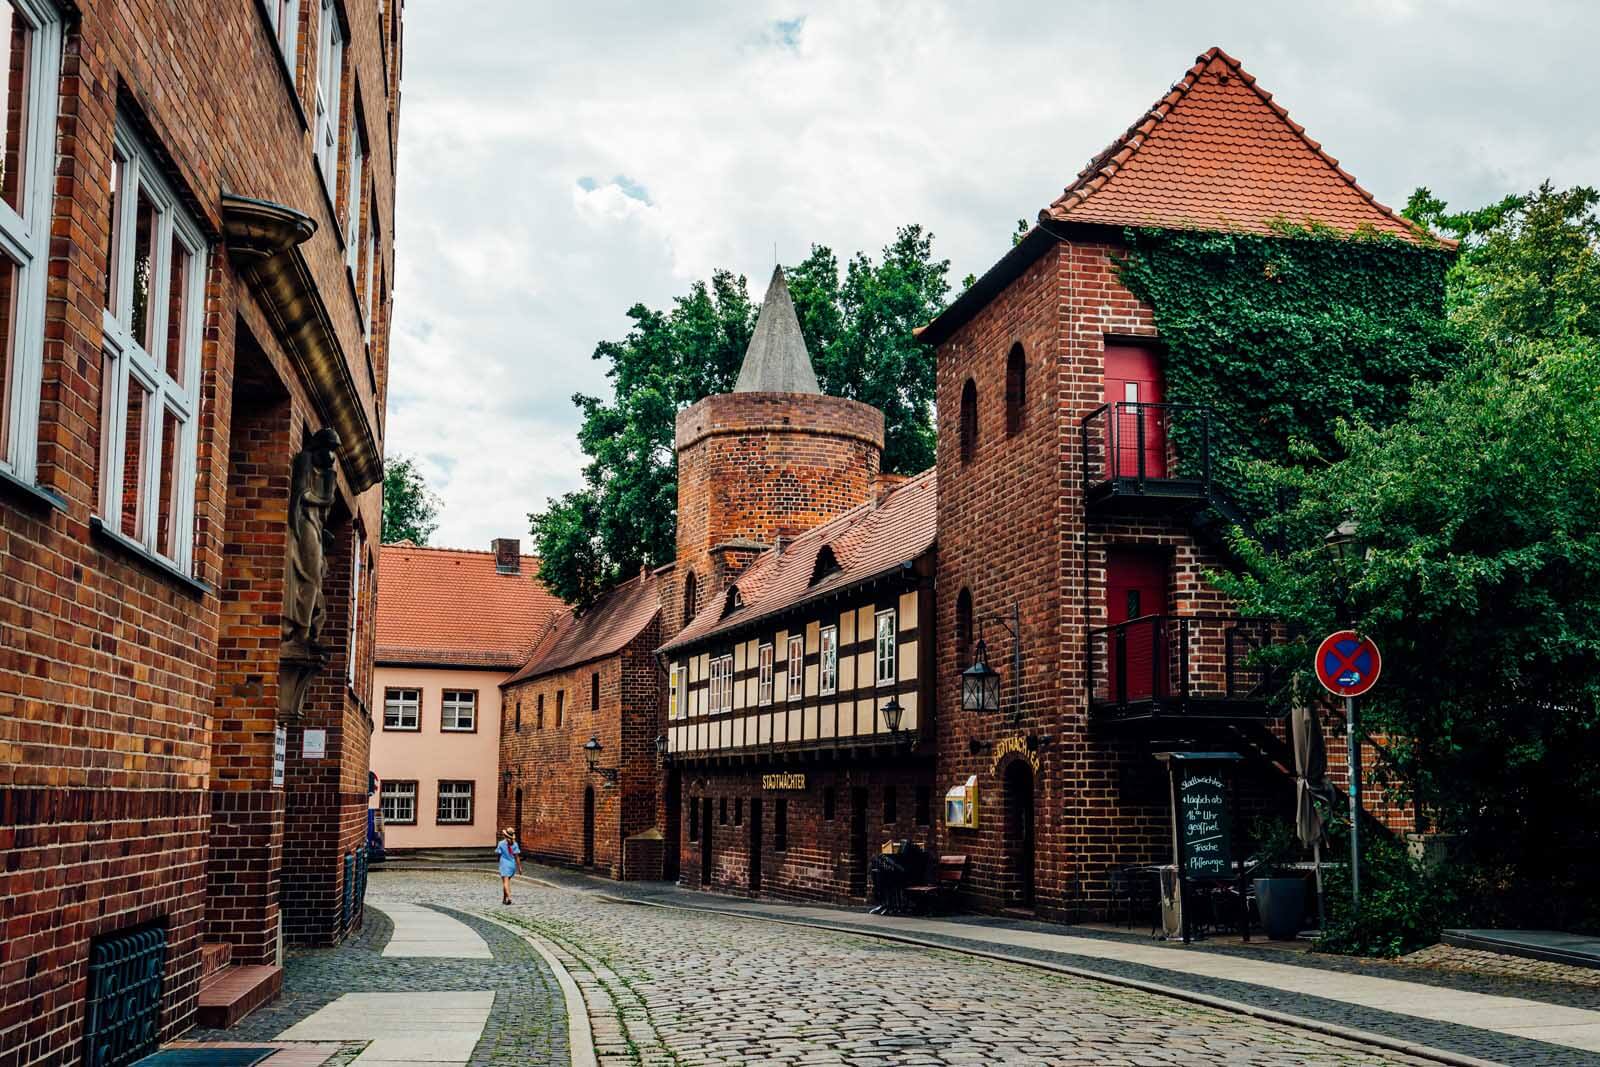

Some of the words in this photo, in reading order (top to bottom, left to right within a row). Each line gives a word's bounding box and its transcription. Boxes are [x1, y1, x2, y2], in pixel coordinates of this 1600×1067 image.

[762, 771, 806, 790] STADTWÄCHTER
[1211, 795, 1223, 804] ab
[1203, 810, 1219, 820] Uhr
